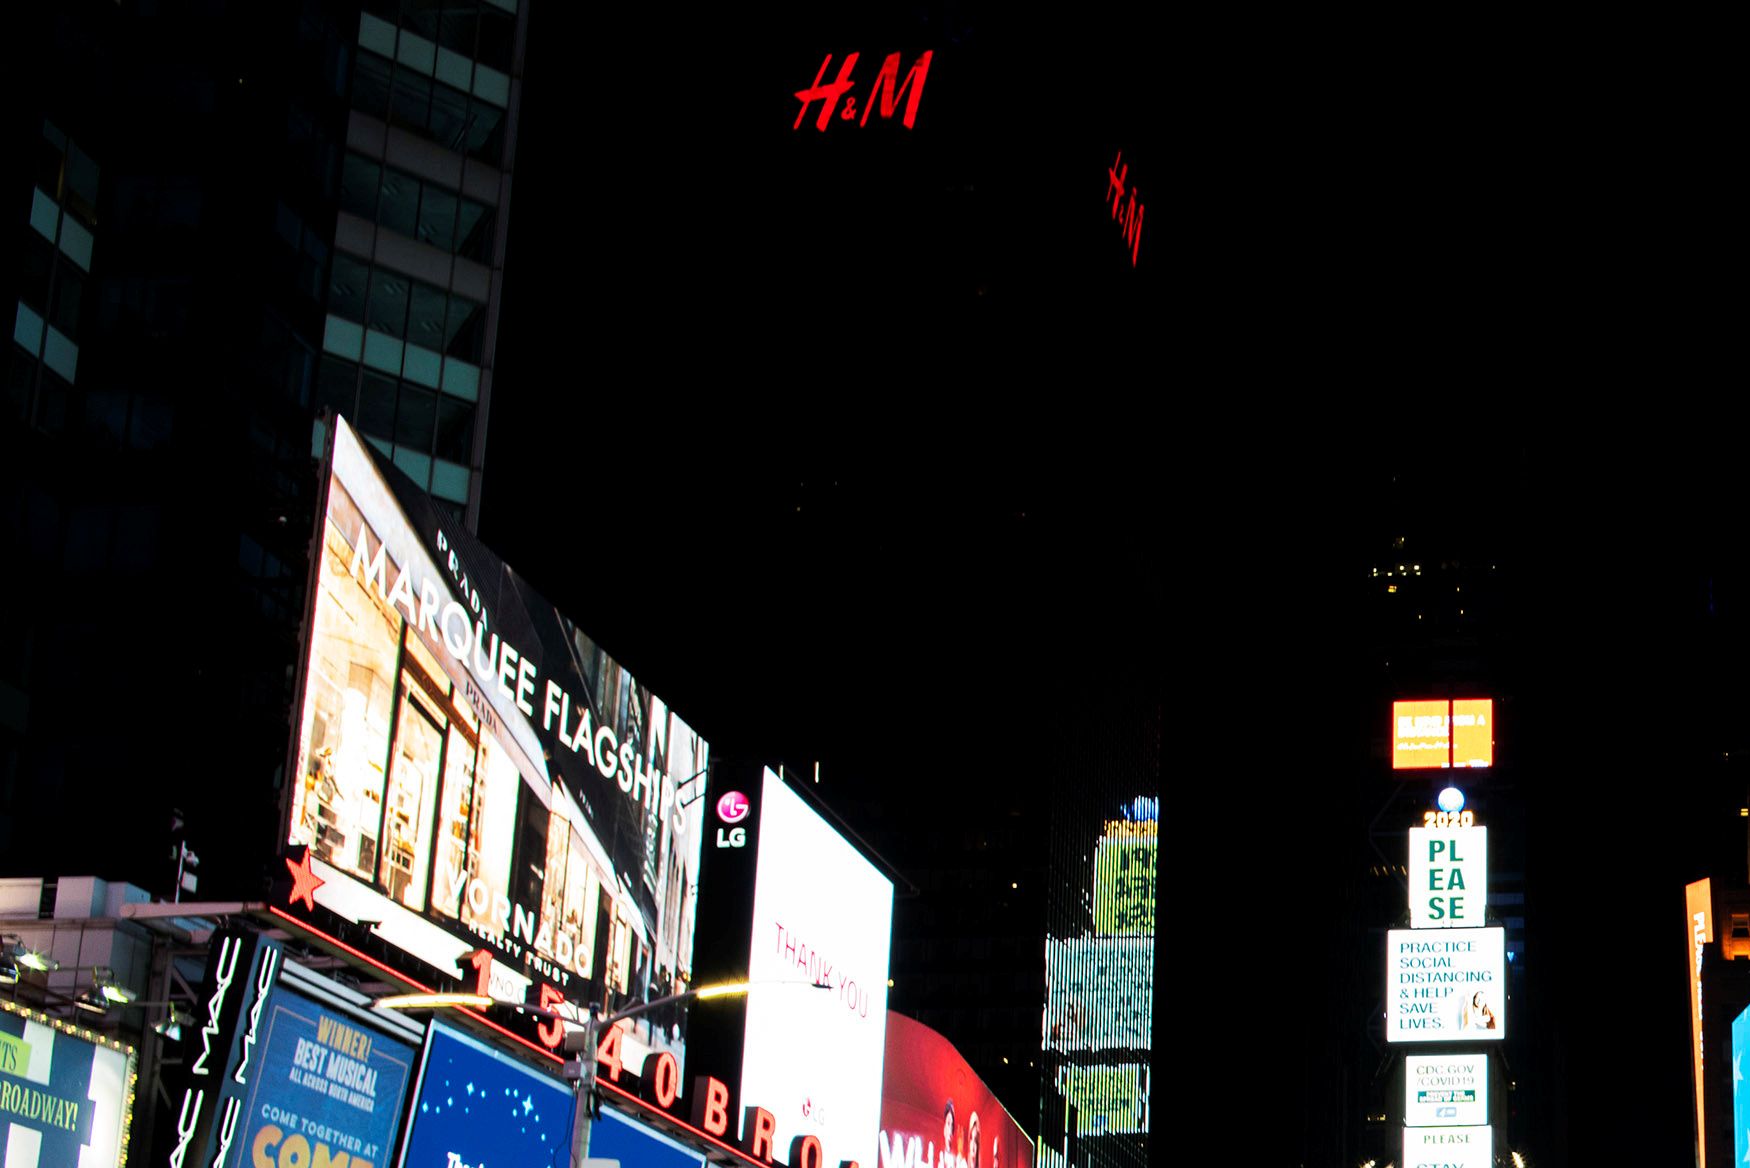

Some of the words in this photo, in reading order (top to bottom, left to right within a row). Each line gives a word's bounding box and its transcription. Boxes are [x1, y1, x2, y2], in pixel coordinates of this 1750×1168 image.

[794, 50, 933, 132] H&M
[1106, 151, 1145, 268] H&M
[437, 528, 489, 632] PRADA
[352, 522, 537, 718] MARQUEE
[543, 679, 688, 835] FLAGSHIPS
[716, 829, 747, 849] LG
[1423, 811, 1474, 829] 2020
[447, 864, 592, 978] VORNADO
[468, 917, 522, 959] REALTY
[525, 950, 570, 987] TRUST
[775, 921, 834, 990] THANK
[837, 973, 869, 1020] YOU
[1399, 941, 1478, 954] PRACTICE
[1399, 956, 1456, 970] SOCIAL
[1399, 970, 1493, 985] DISTANCING
[1413, 985, 1454, 999] HELP
[1399, 1001, 1439, 1015] SAVE
[1399, 1017, 1445, 1030] LIVES.
[316, 1014, 374, 1063] WINNER!
[289, 1066, 302, 1083] ALL
[302, 1072, 329, 1096] ACROSS
[293, 1036, 329, 1074] BEST
[325, 1050, 379, 1099] MUSICAL
[0, 1079, 80, 1133] ROADWAY!
[261, 1103, 299, 1129] COME
[301, 1117, 363, 1151] TOGETHER
[364, 1142, 379, 1159] AT
[1423, 1134, 1472, 1144] PLEASE
